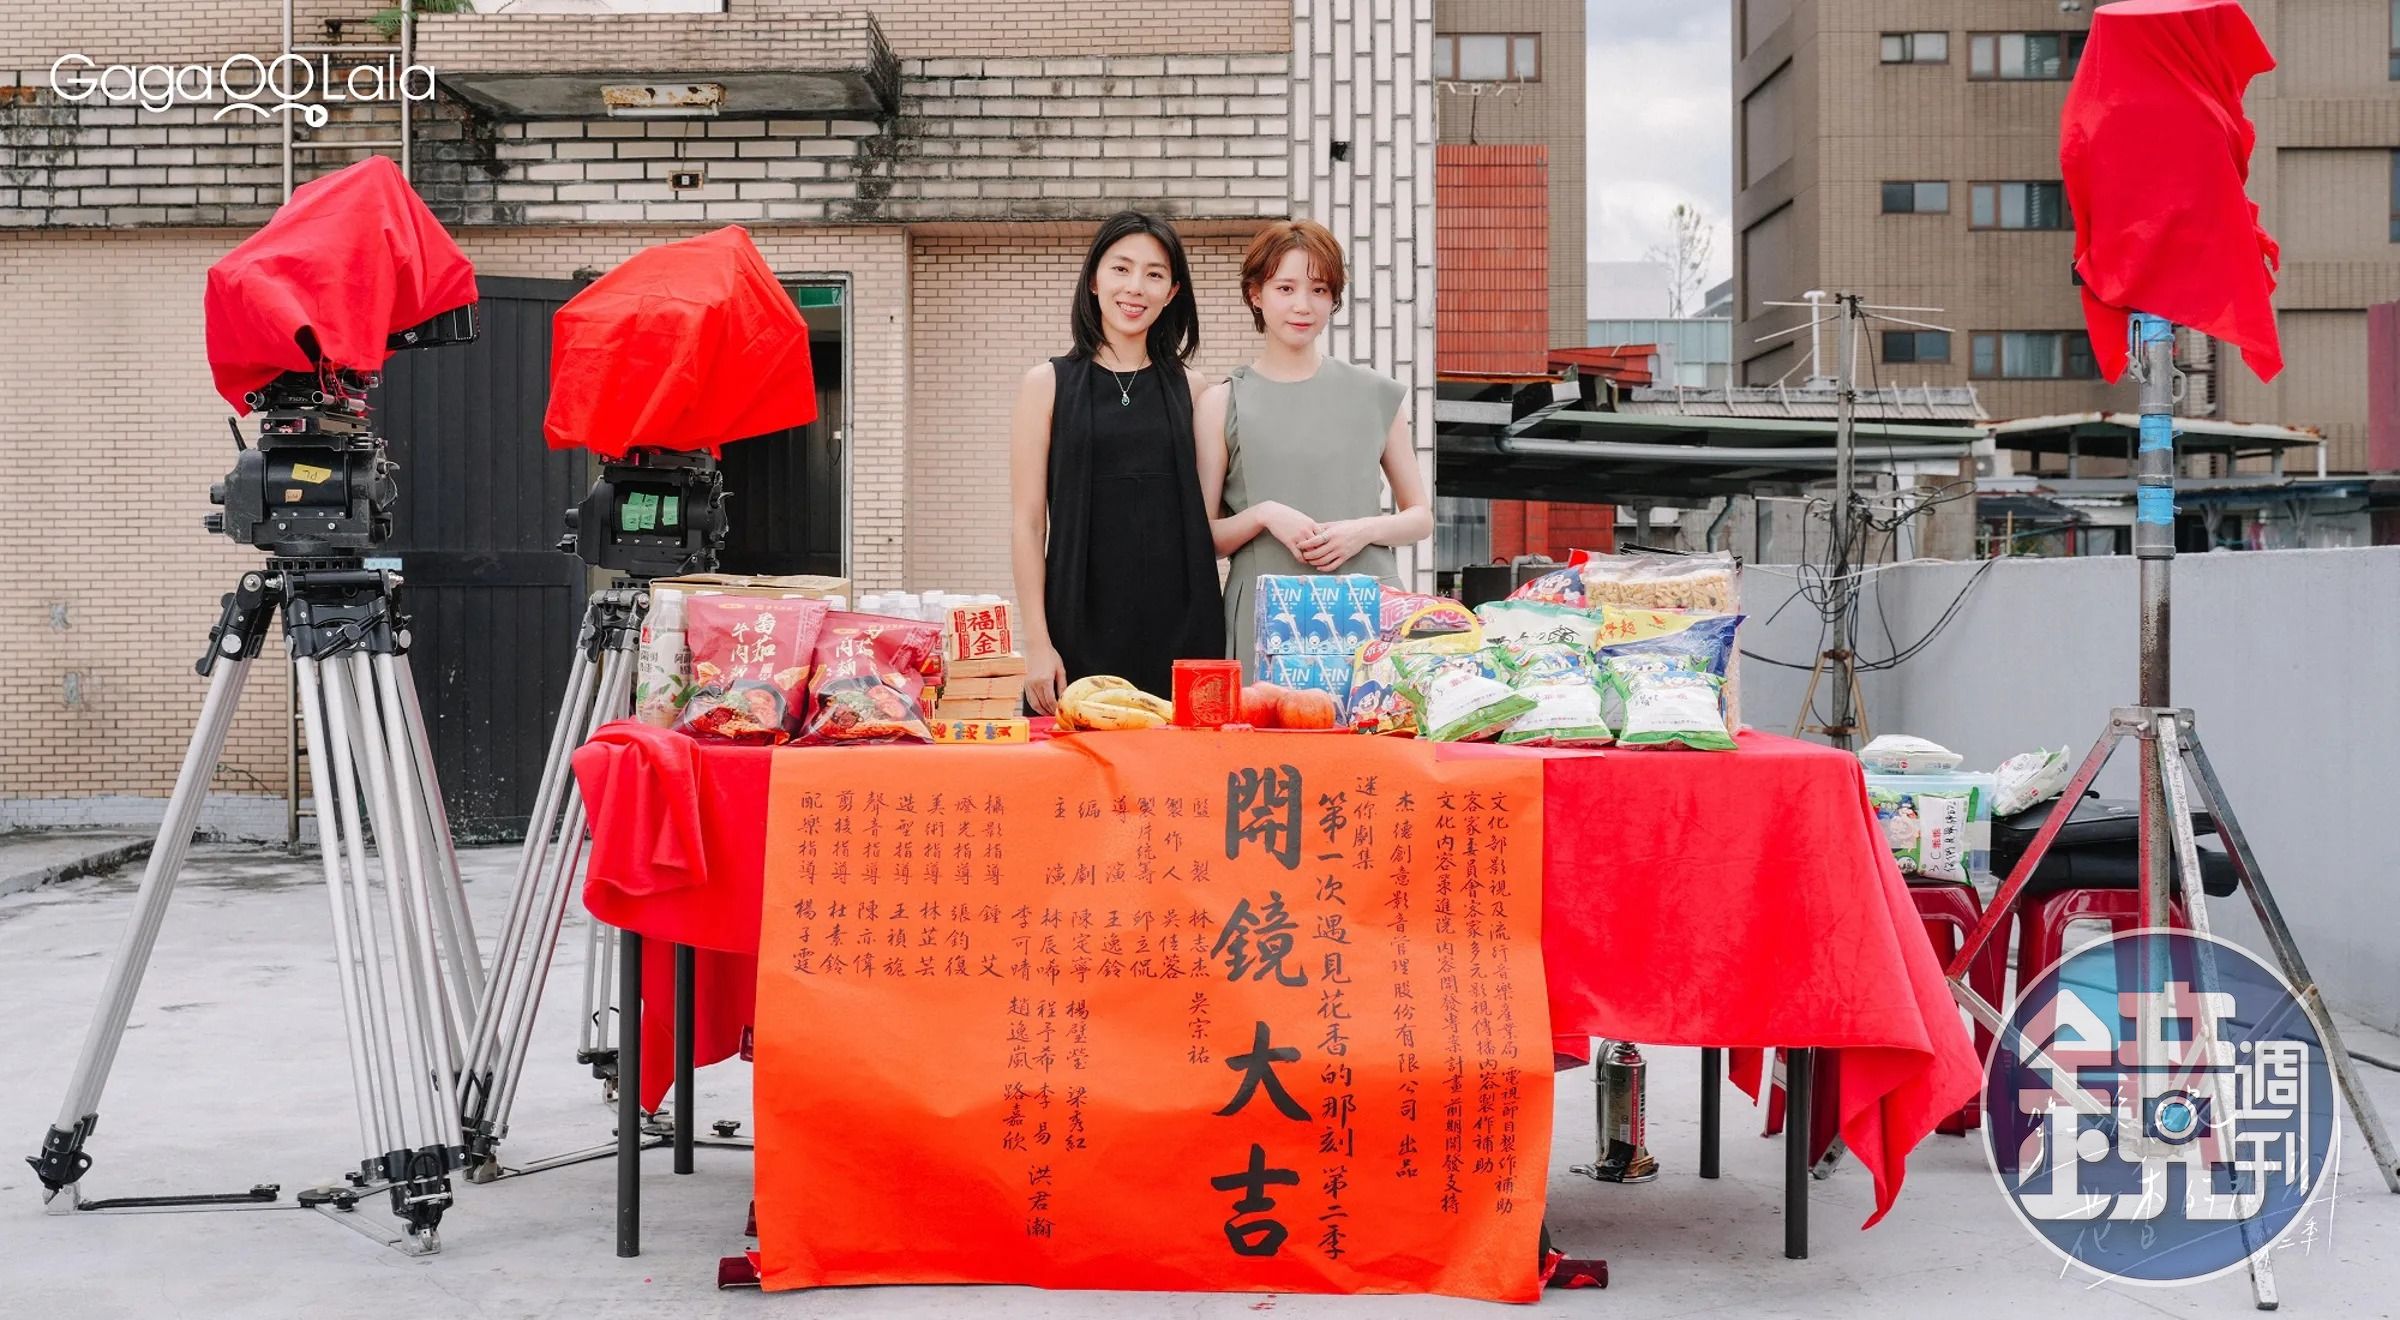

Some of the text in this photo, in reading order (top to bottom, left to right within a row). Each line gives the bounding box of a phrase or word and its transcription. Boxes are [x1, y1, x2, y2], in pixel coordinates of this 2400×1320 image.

[1271, 588, 1303, 602] FIN
[1311, 588, 1340, 602] FIN
[1348, 587, 1377, 602] FIN
[752, 613, 777, 664] 番茄
[967, 610, 999, 656] 福金
[1280, 667, 1311, 682] FIN
[1319, 667, 1350, 682] FIN
[1210, 764, 1313, 1258] 開鏡大吉
